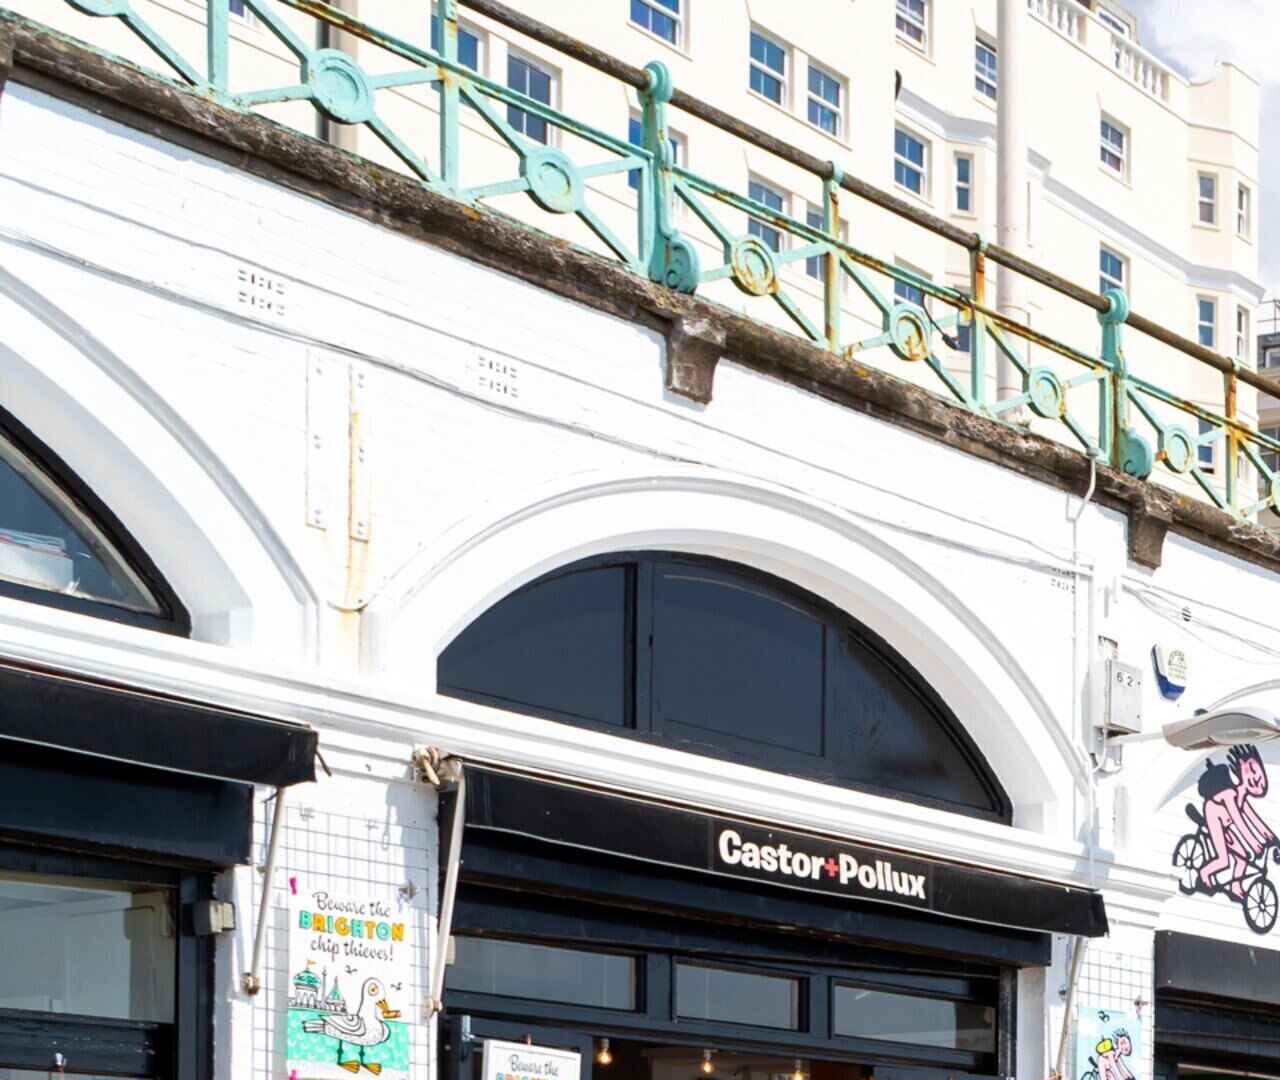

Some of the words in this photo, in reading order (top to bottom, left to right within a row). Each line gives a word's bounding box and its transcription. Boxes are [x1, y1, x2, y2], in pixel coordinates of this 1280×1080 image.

[312, 891, 365, 916] Beware
[370, 901, 391, 918] the
[298, 910, 405, 942] BRIGHTON
[310, 935, 340, 962] chip
[343, 940, 394, 962] thieves!
[508, 1053, 542, 1075] Beware
[544, 1061, 560, 1077] the
